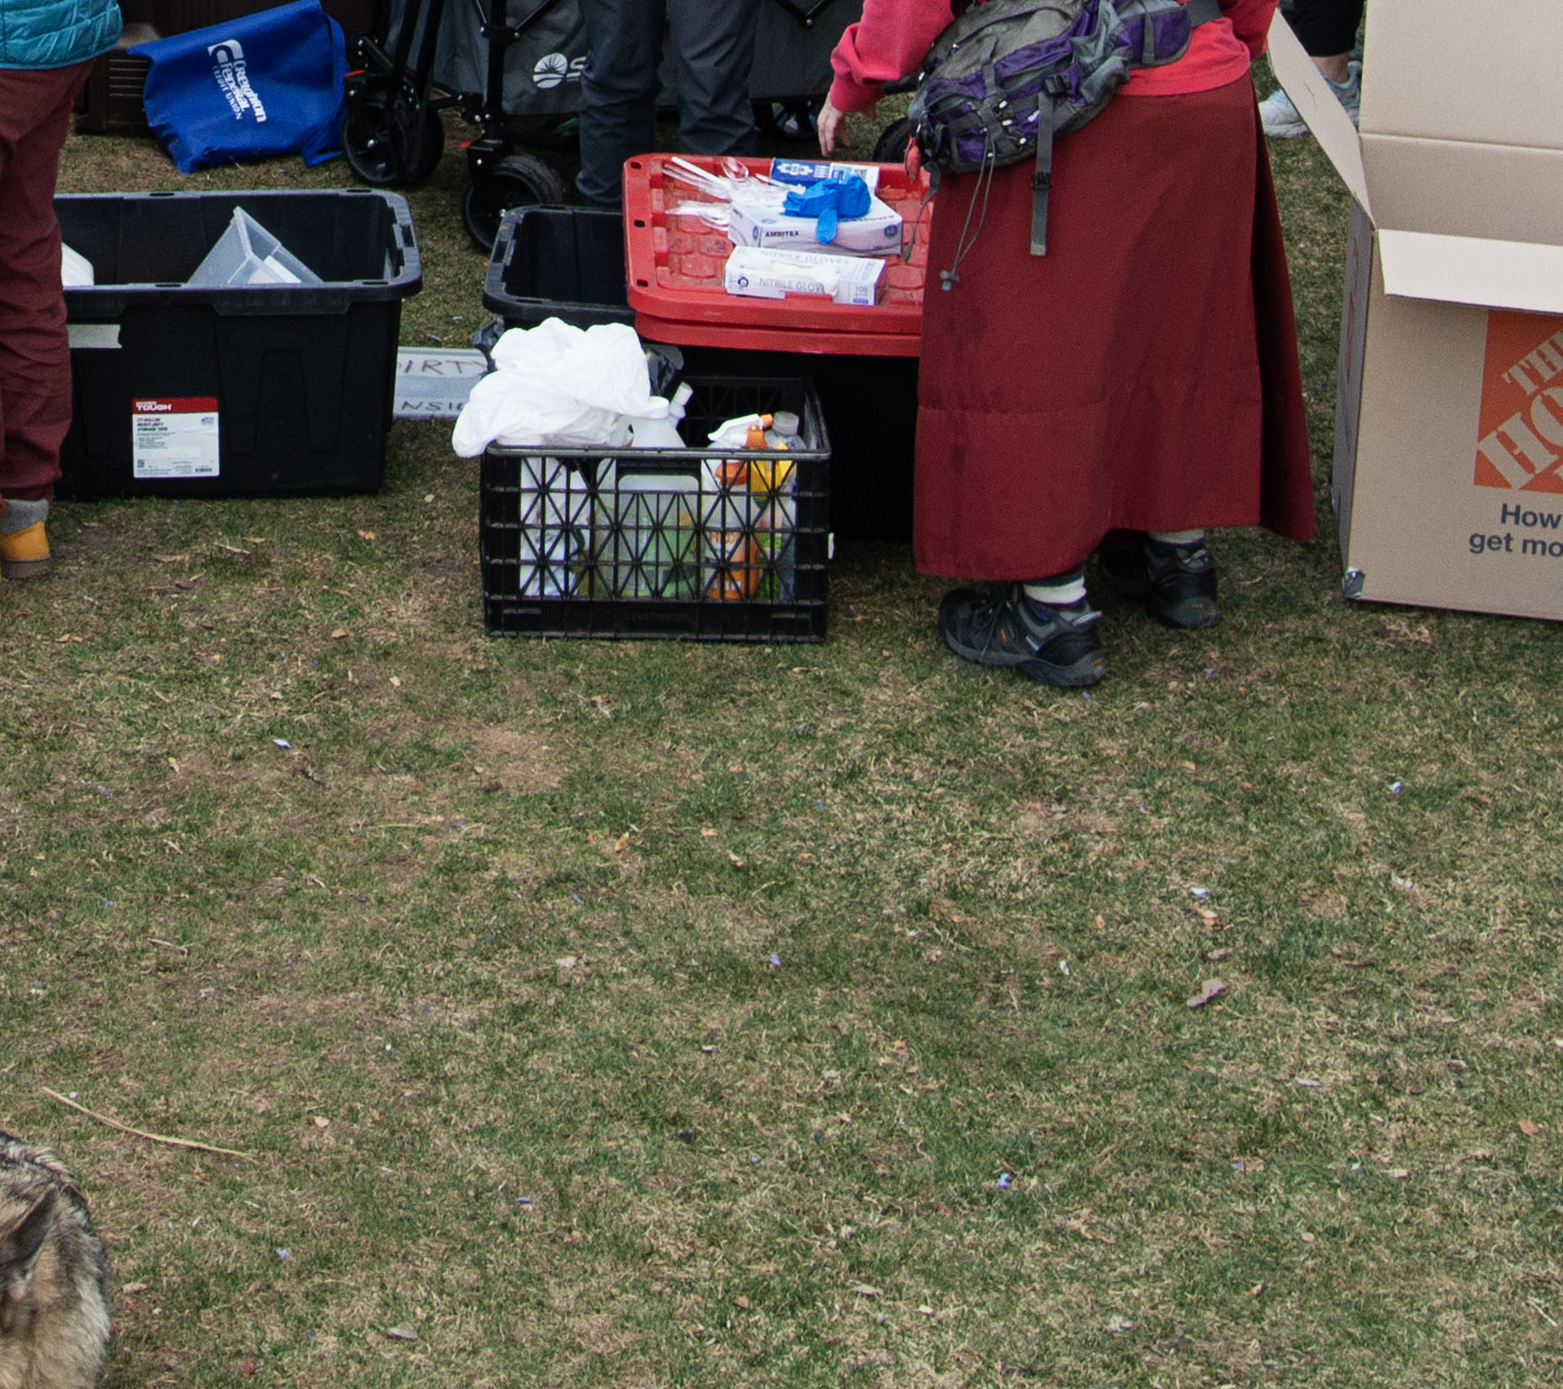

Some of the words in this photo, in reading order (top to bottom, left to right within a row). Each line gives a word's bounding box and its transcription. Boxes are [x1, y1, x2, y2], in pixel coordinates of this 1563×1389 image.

[220, 62, 250, 112] Federal
[234, 59, 267, 123] Creighton
[225, 92, 243, 120] UNION
[759, 278, 794, 291] NITRILE
[795, 281, 826, 293] GLOV
[1500, 502, 1563, 530] How
[1468, 531, 1514, 555] get
